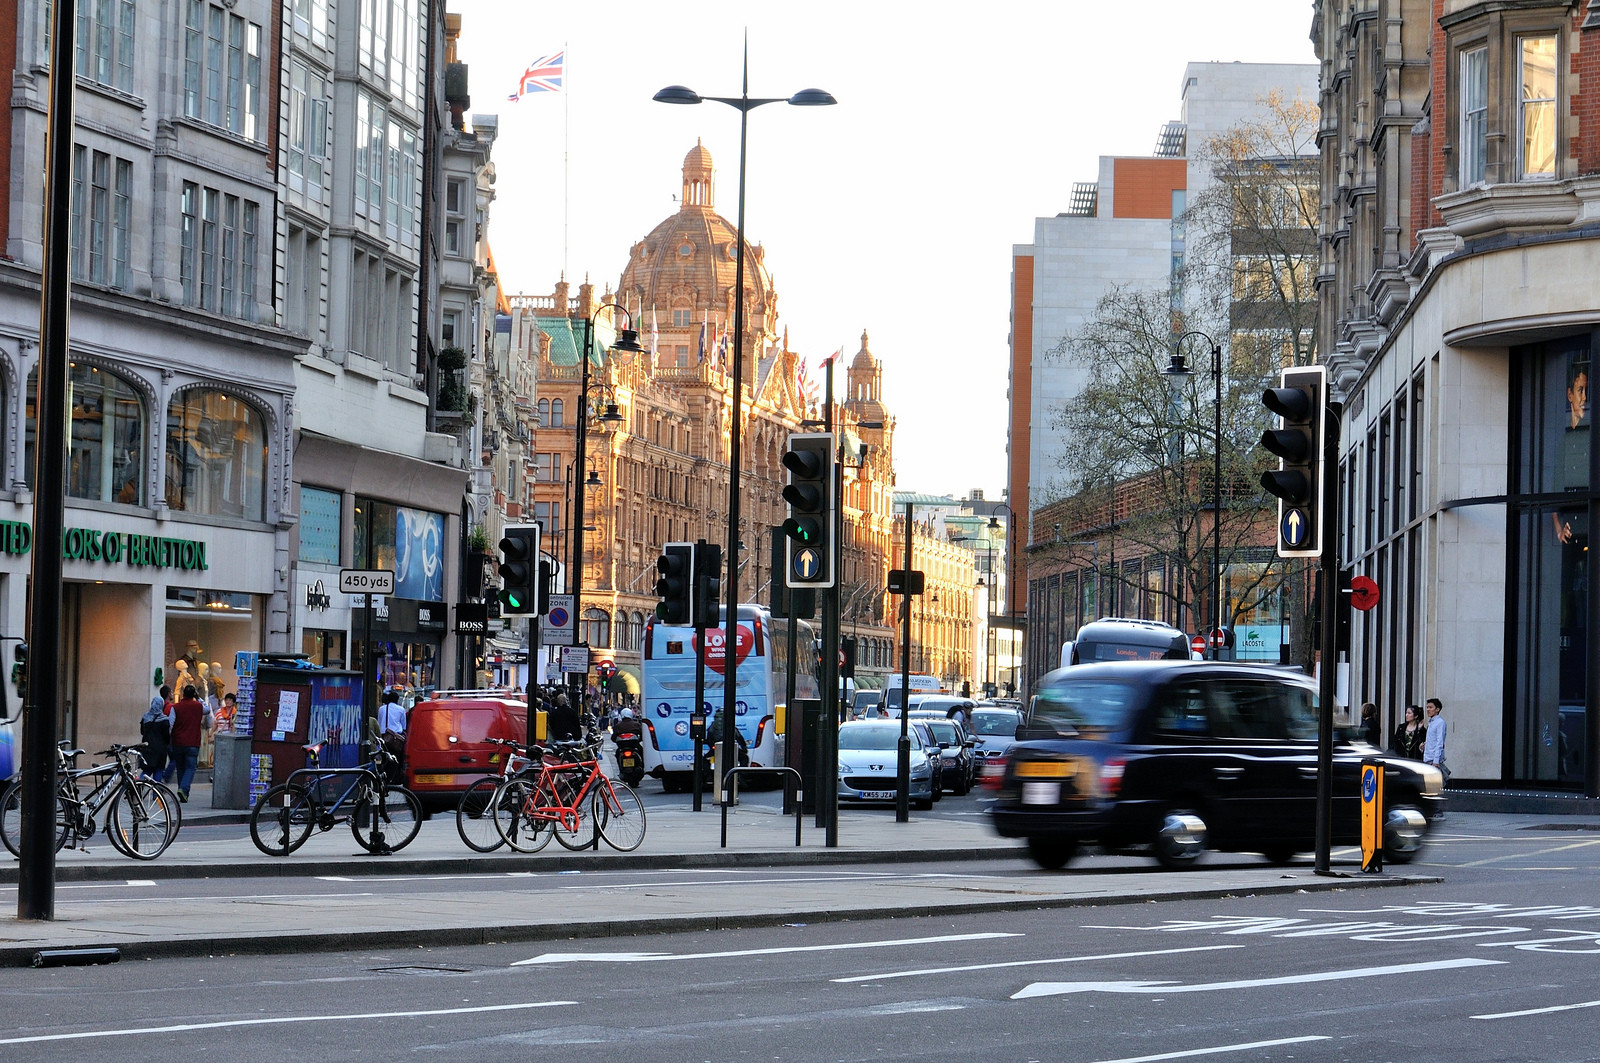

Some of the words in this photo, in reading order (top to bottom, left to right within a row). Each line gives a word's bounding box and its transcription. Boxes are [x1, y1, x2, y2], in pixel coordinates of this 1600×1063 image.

[102, 531, 128, 563] OF
[344, 576, 368, 587] 450
[370, 576, 389, 589] yds
[419, 608, 431, 621] BOSS
[459, 621, 484, 629] BOSS
[1116, 648, 1138, 656] London
[340, 704, 361, 745] BOYS
[672, 752, 695, 761] natio
